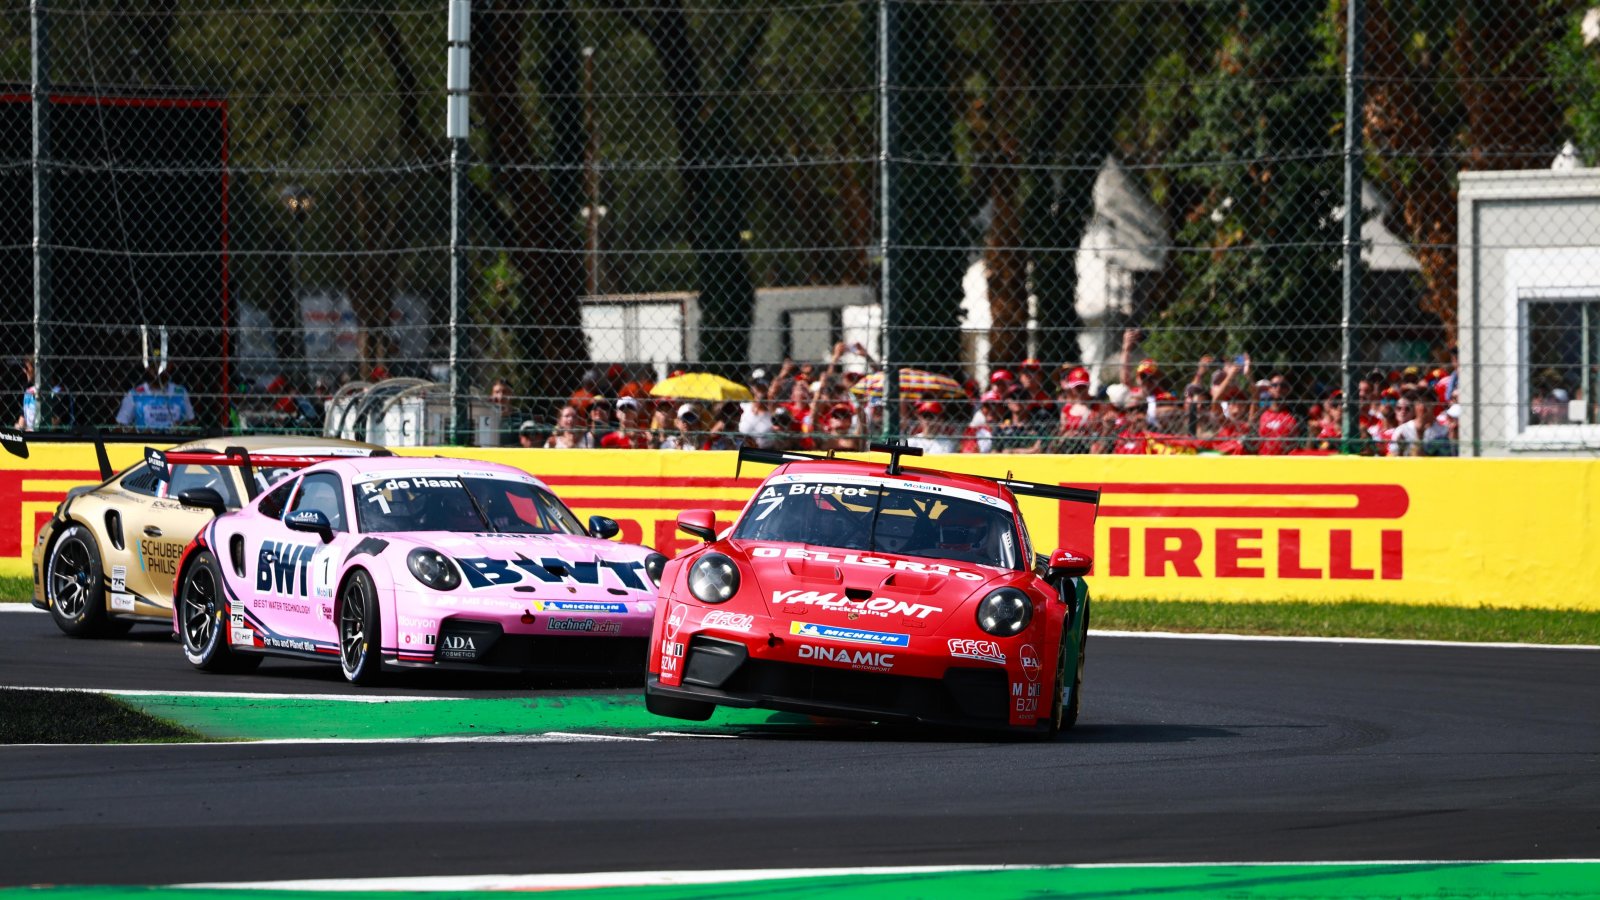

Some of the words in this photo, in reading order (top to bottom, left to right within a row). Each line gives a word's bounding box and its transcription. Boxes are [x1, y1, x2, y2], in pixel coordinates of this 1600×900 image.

[361, 482, 382, 495] R.
[386, 480, 410, 490] de
[414, 478, 464, 488] Haan
[760, 486, 782, 500] A.
[789, 484, 869, 497] Bristot
[368, 494, 392, 514] 1
[755, 496, 785, 520] 7
[298, 511, 318, 519] ADA
[1059, 482, 1410, 580] PIRELLI
[148, 558, 176, 575] PHILIS
[256, 540, 316, 597] BWT
[324, 557, 330, 585] 1
[752, 548, 984, 581] DELLORTO
[453, 555, 649, 592] BWT
[113, 578, 125, 586] 75
[254, 600, 267, 608] BEST
[268, 601, 282, 610] WATER
[282, 602, 310, 614] TECHNOLOGY
[772, 590, 942, 619] VALMONT
[822, 604, 888, 617] Packaging
[232, 614, 243, 622] 75
[442, 636, 476, 650] ADA
[824, 629, 900, 642] MICHELIN
[272, 638, 280, 647] You
[280, 640, 290, 648] and
[290, 640, 304, 650] Planet
[798, 644, 895, 668] DINAMIC
[852, 664, 890, 672] MOTORSPORT
[1016, 698, 1038, 712] BZM
